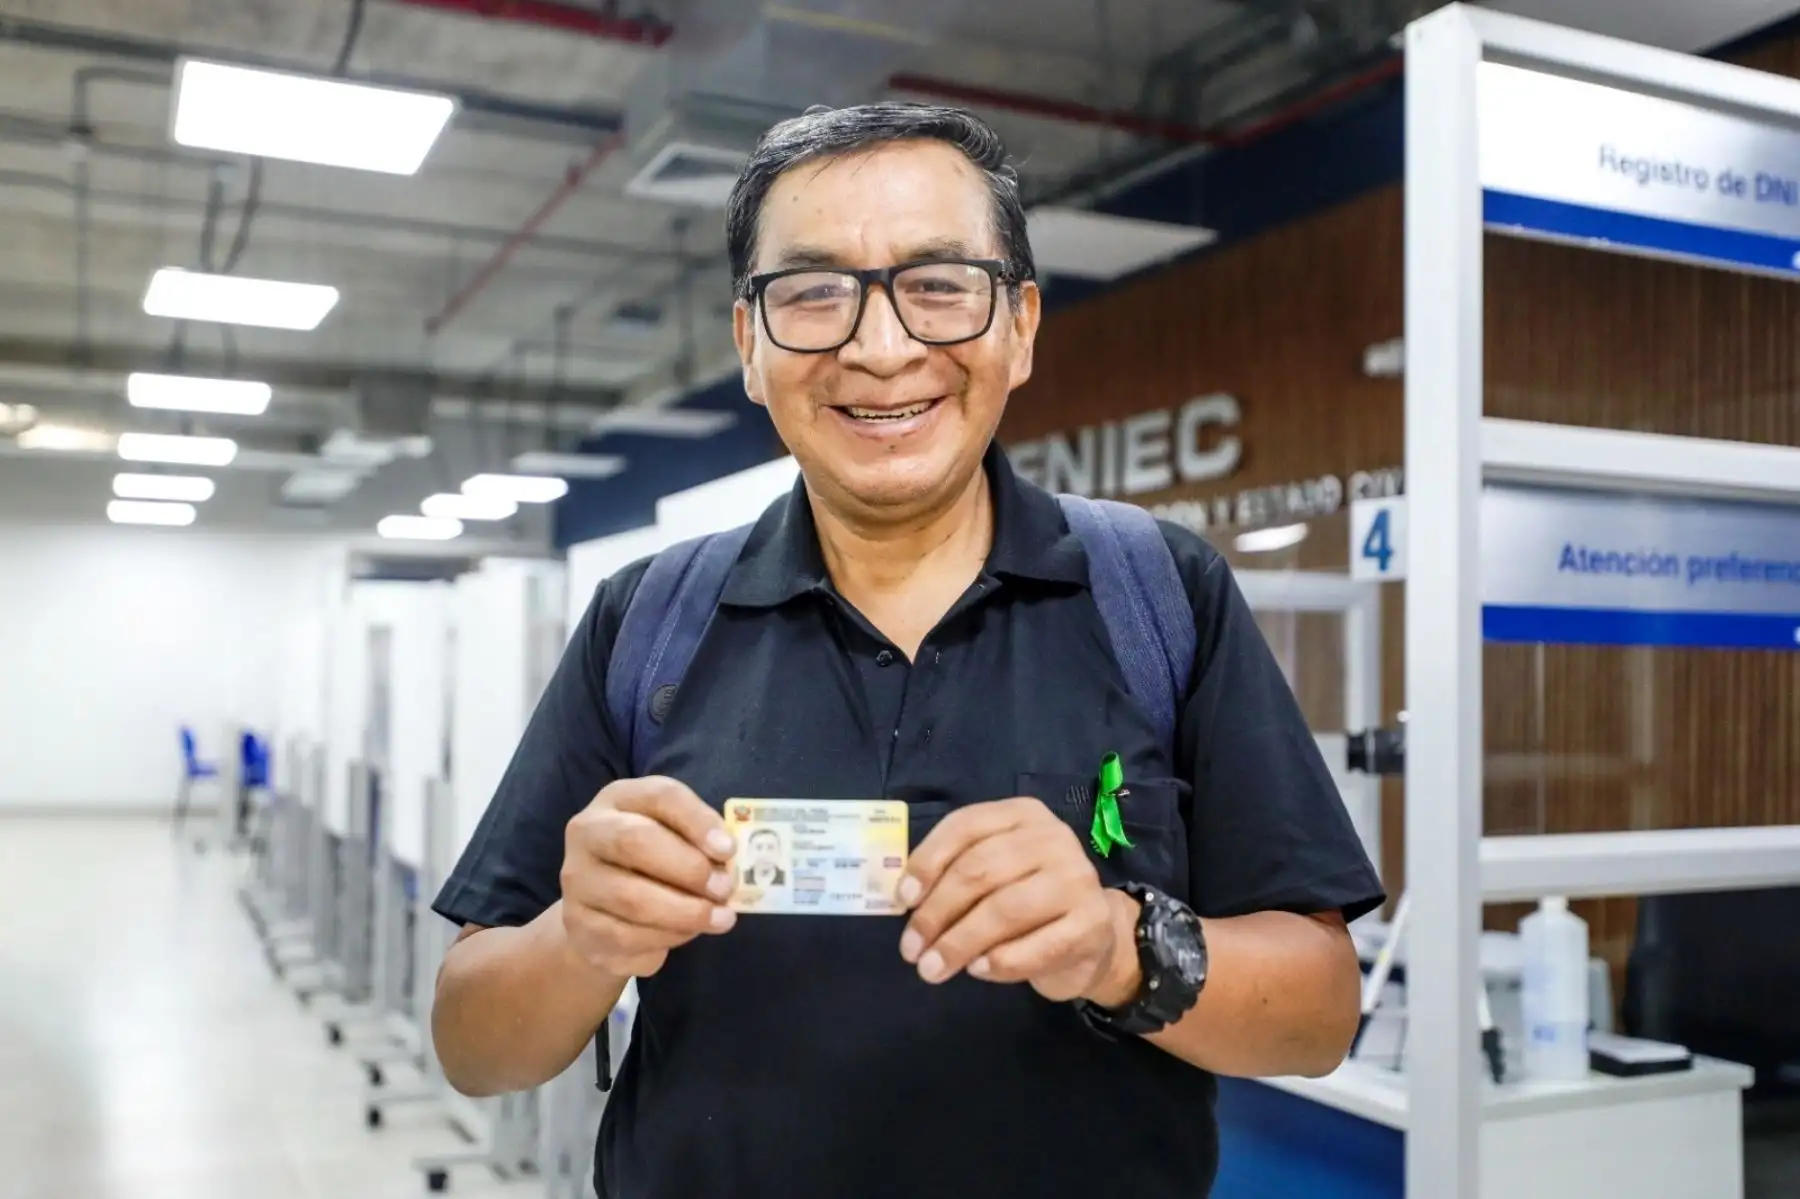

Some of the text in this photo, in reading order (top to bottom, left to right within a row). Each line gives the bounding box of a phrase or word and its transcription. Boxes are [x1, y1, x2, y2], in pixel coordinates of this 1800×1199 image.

[1599, 143, 1709, 190] Registro
[1717, 168, 1747, 198] de
[1009, 393, 1242, 499] ENIEC
[1362, 507, 1394, 572] 4
[1558, 541, 1680, 577] Atención
